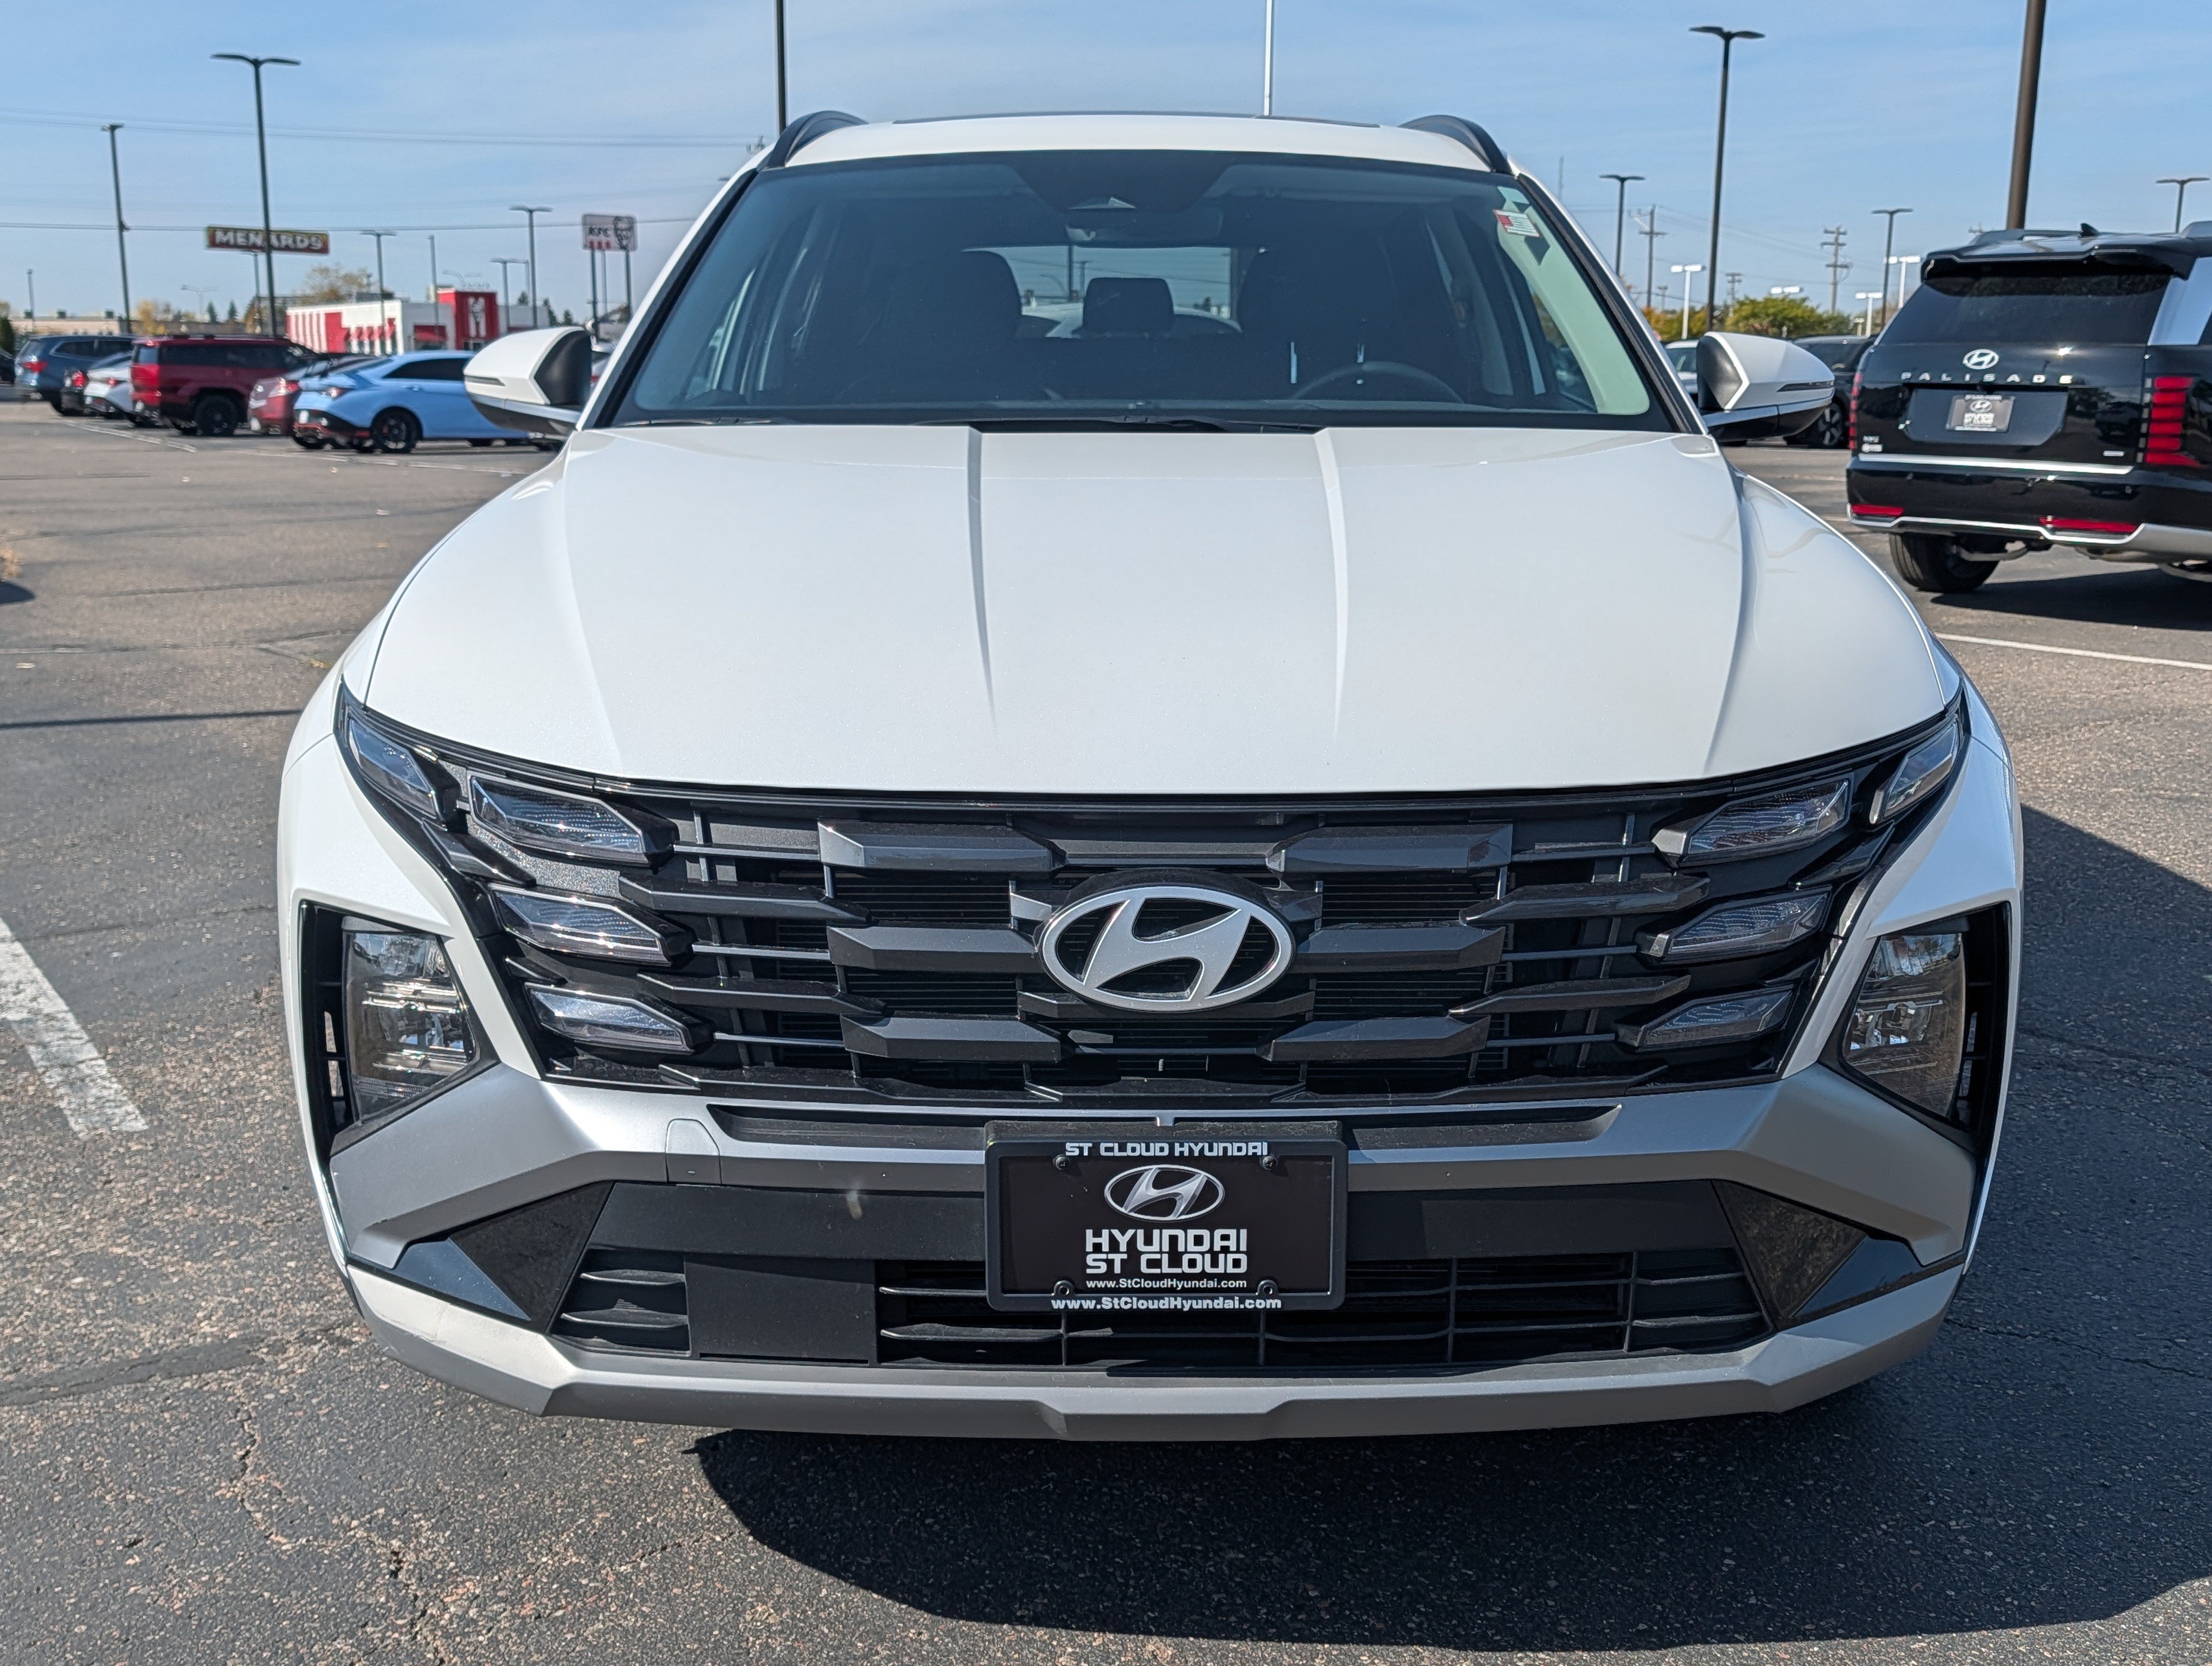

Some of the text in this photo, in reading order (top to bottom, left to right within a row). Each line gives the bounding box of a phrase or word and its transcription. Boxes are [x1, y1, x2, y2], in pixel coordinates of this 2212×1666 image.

[1901, 372, 2073, 383] PALISADE
[1065, 1142, 1268, 1156] ST CLOUD HYUNDAI
[1085, 1228, 1247, 1252] HYUNDAI
[1086, 1253, 1247, 1274] ST CLOUD
[1085, 1278, 1247, 1290] www.StCloudHyundai.com
[1051, 1296, 1282, 1311] www.StCloudHyundai.com
